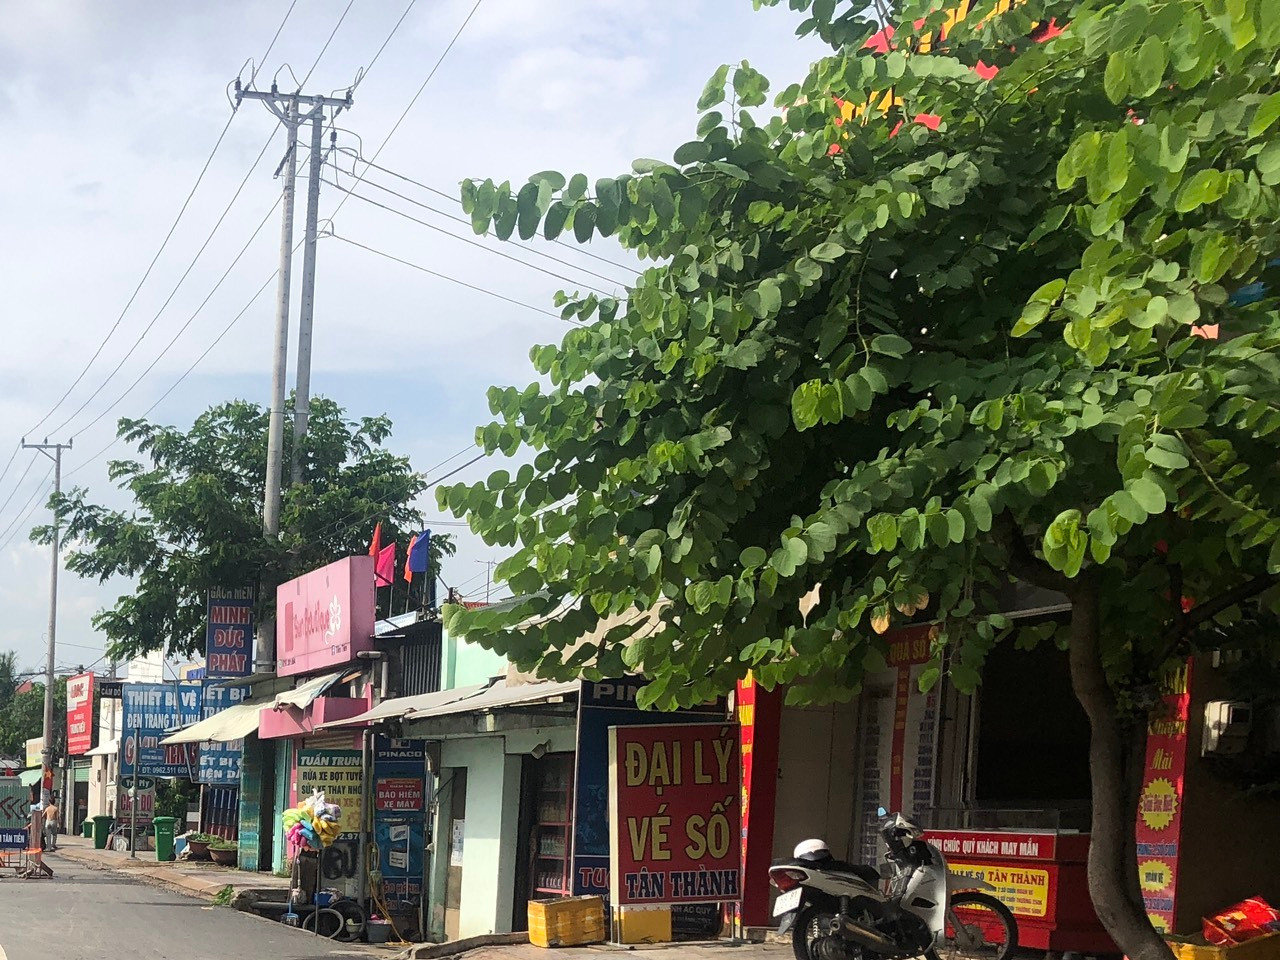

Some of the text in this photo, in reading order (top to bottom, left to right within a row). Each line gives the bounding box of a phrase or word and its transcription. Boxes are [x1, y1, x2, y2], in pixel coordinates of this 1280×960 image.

[210, 605, 250, 625] MINH
[213, 625, 244, 648] ĐỨC
[209, 650, 247, 672] PHÁT
[127, 687, 162, 706] THIẾT
[144, 713, 169, 729] TRANG
[300, 752, 363, 766] TUẤN TRUN
[625, 727, 734, 797] ĐẠI LÝ
[1150, 748, 1174, 770] Mãi
[303, 768, 317, 781] RỬA
[319, 771, 328, 781] XE
[328, 786, 345, 795] THAY
[384, 799, 415, 808] XE MÁY
[627, 795, 733, 862] VÉ SỐ
[943, 837, 960, 853] CHÚC
[962, 838, 976, 854] QUÝ
[977, 838, 999, 855] KHÁCH
[1001, 841, 1018, 855] MAY
[1019, 837, 1039, 857] MẮN
[624, 863, 738, 900] TÂN THÀNH
[988, 868, 1010, 883] TÂN
[1011, 870, 1045, 886] THÀNH
